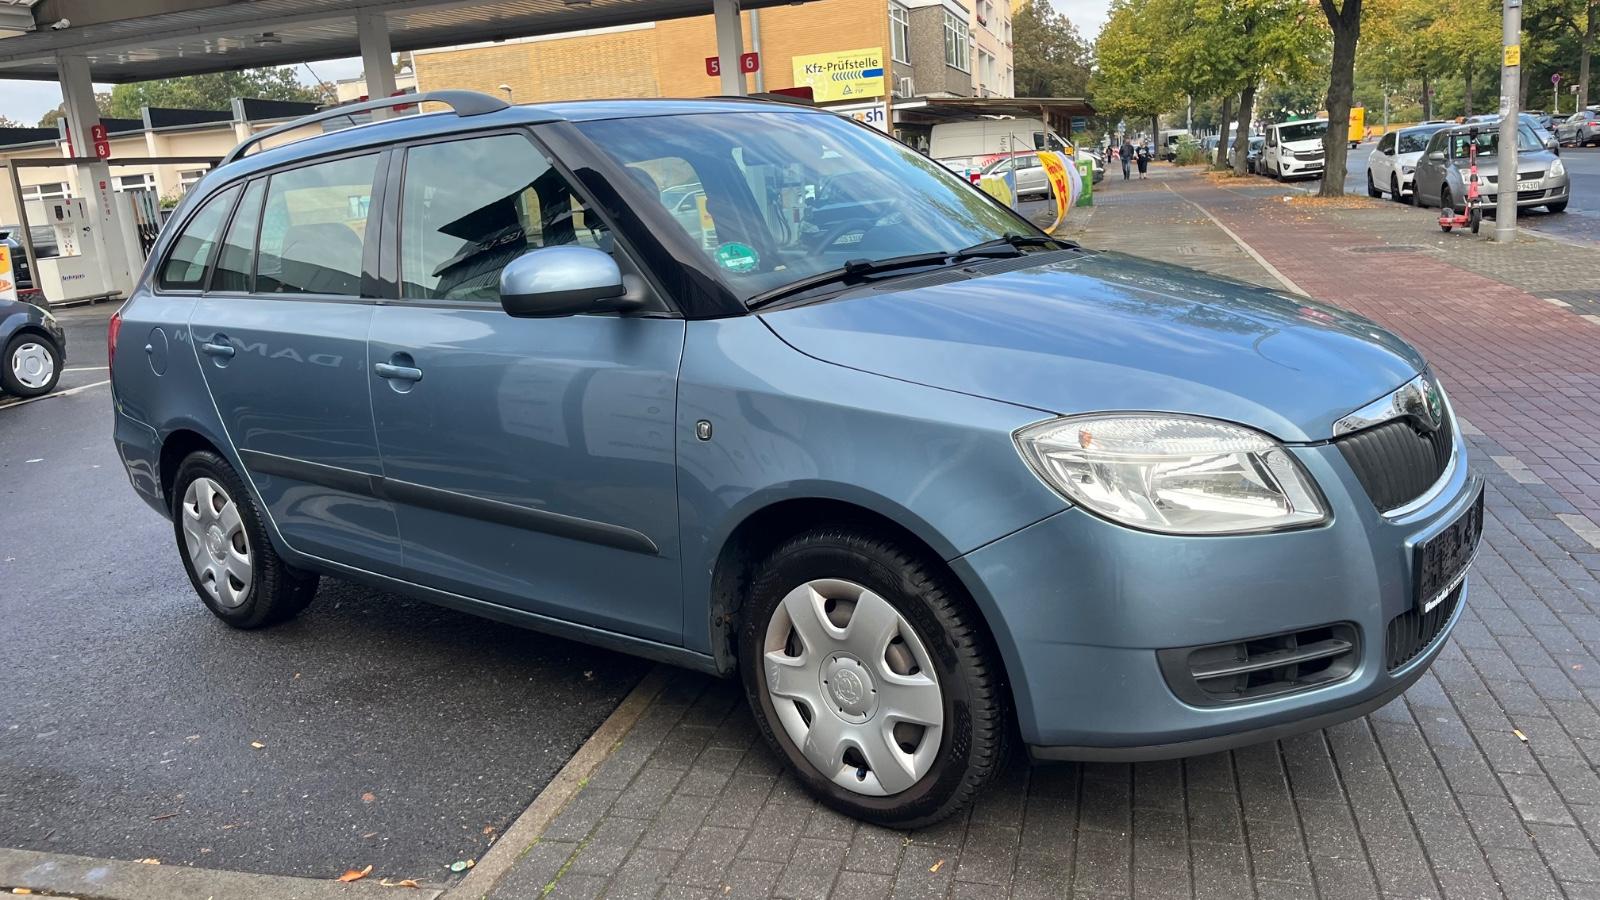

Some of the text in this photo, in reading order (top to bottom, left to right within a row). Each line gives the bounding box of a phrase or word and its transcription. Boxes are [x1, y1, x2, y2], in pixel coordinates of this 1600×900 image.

[711, 60, 719, 73] 5
[745, 56, 754, 69] 6
[805, 57, 878, 74] Kfz-Prüfstelle
[851, 107, 883, 123] ash
[95, 128, 102, 139] 2
[98, 145, 106, 156] 8
